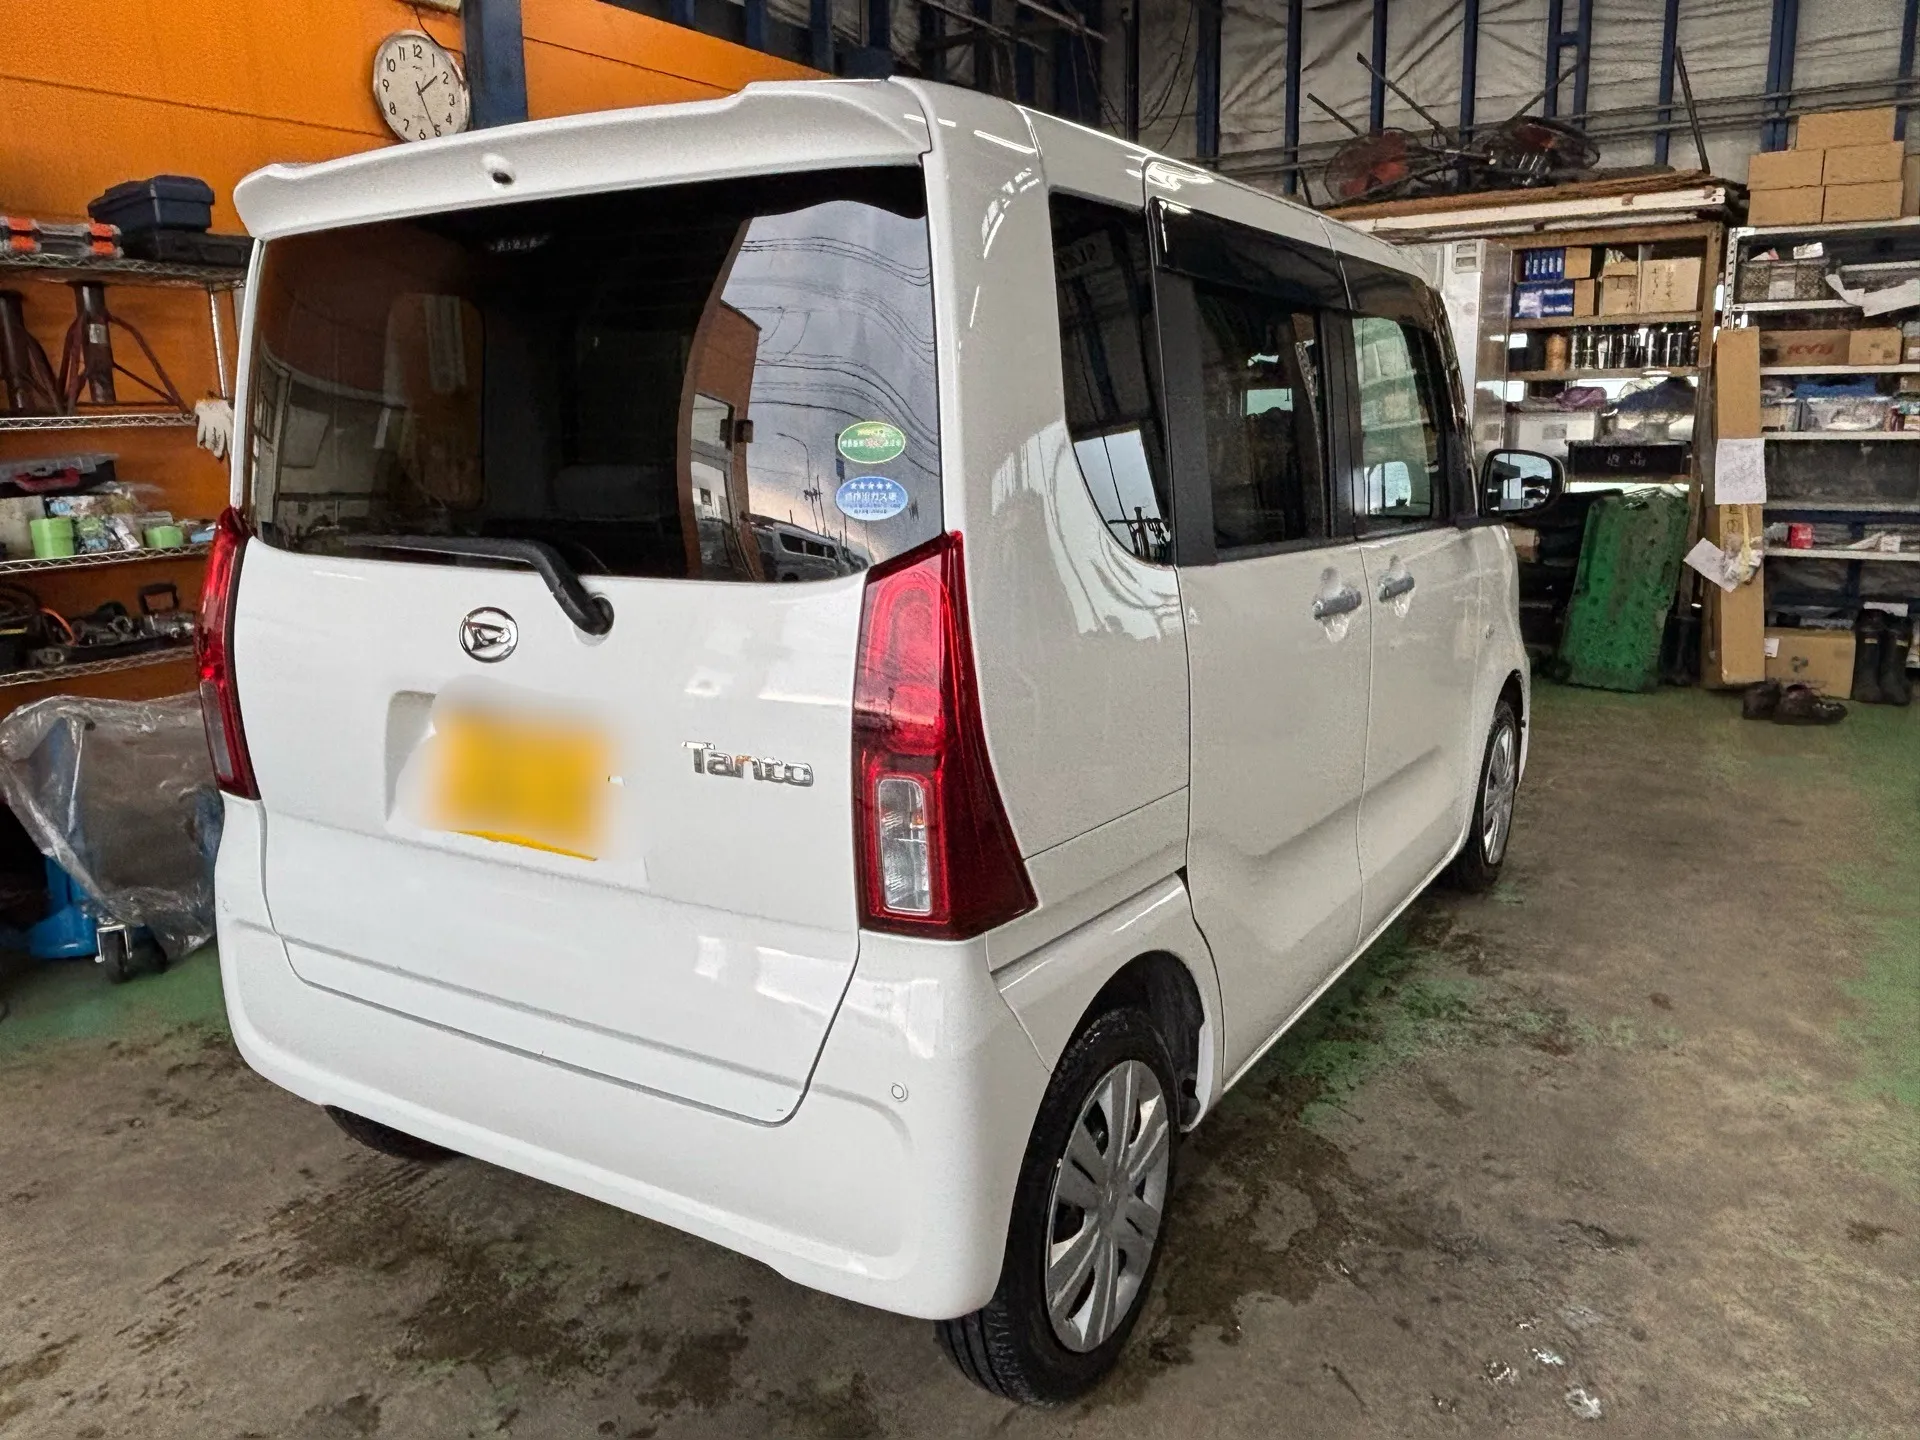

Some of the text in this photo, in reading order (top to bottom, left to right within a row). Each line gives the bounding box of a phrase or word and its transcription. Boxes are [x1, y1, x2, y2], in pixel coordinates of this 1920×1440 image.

[398, 46, 405, 61] 11
[413, 44, 422, 59] 12
[386, 58, 396, 72] 10
[431, 53, 435, 68] 1
[442, 71, 449, 84] 2
[382, 79, 390, 92] 9
[448, 93, 455, 106] 3
[389, 102, 396, 115] 8
[403, 118, 410, 132] 7
[446, 113, 452, 125] 4
[419, 129, 426, 140] 6
[434, 125, 442, 137] 5
[681, 740, 814, 787] Tanto
